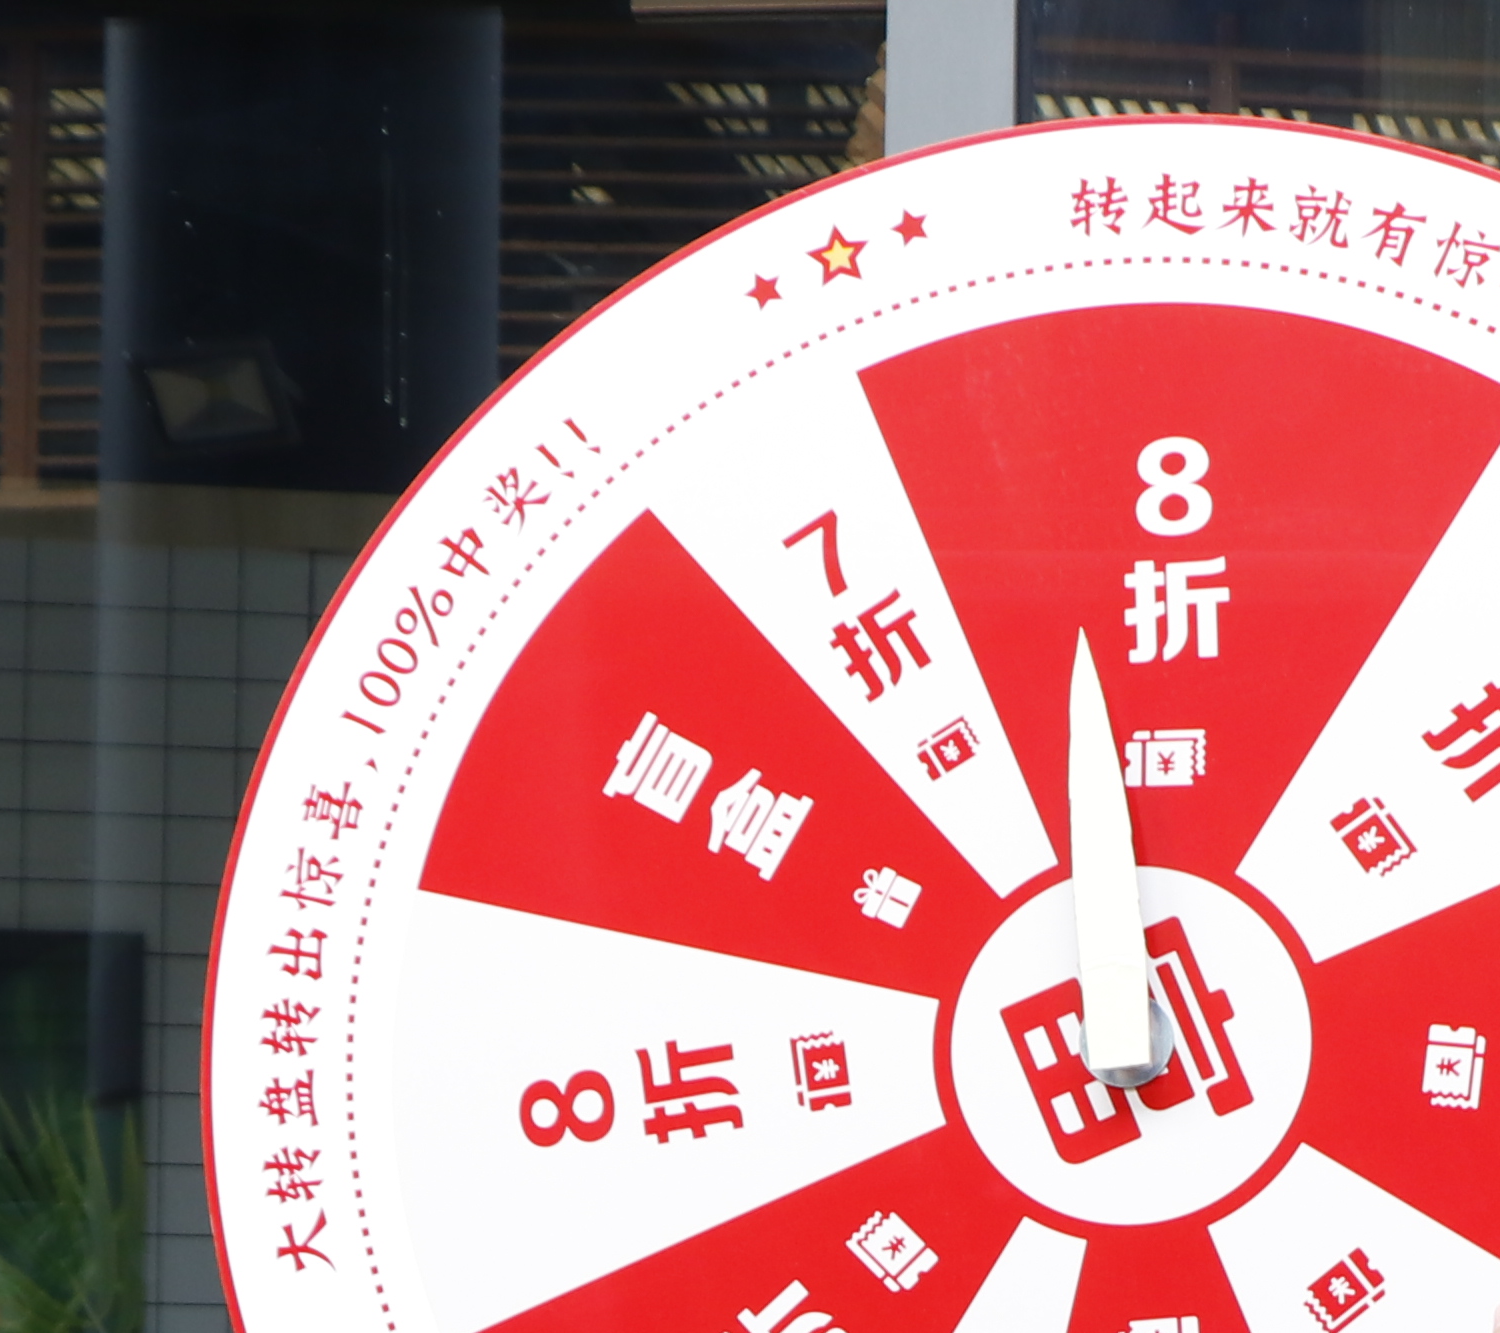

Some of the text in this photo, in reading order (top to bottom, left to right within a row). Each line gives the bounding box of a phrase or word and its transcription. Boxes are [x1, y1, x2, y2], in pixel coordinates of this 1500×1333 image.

[780, 510, 931, 702] 7折
[1123, 434, 1231, 666] 8折
[603, 712, 817, 885] 盲盒
[519, 1038, 748, 1147] 8折
